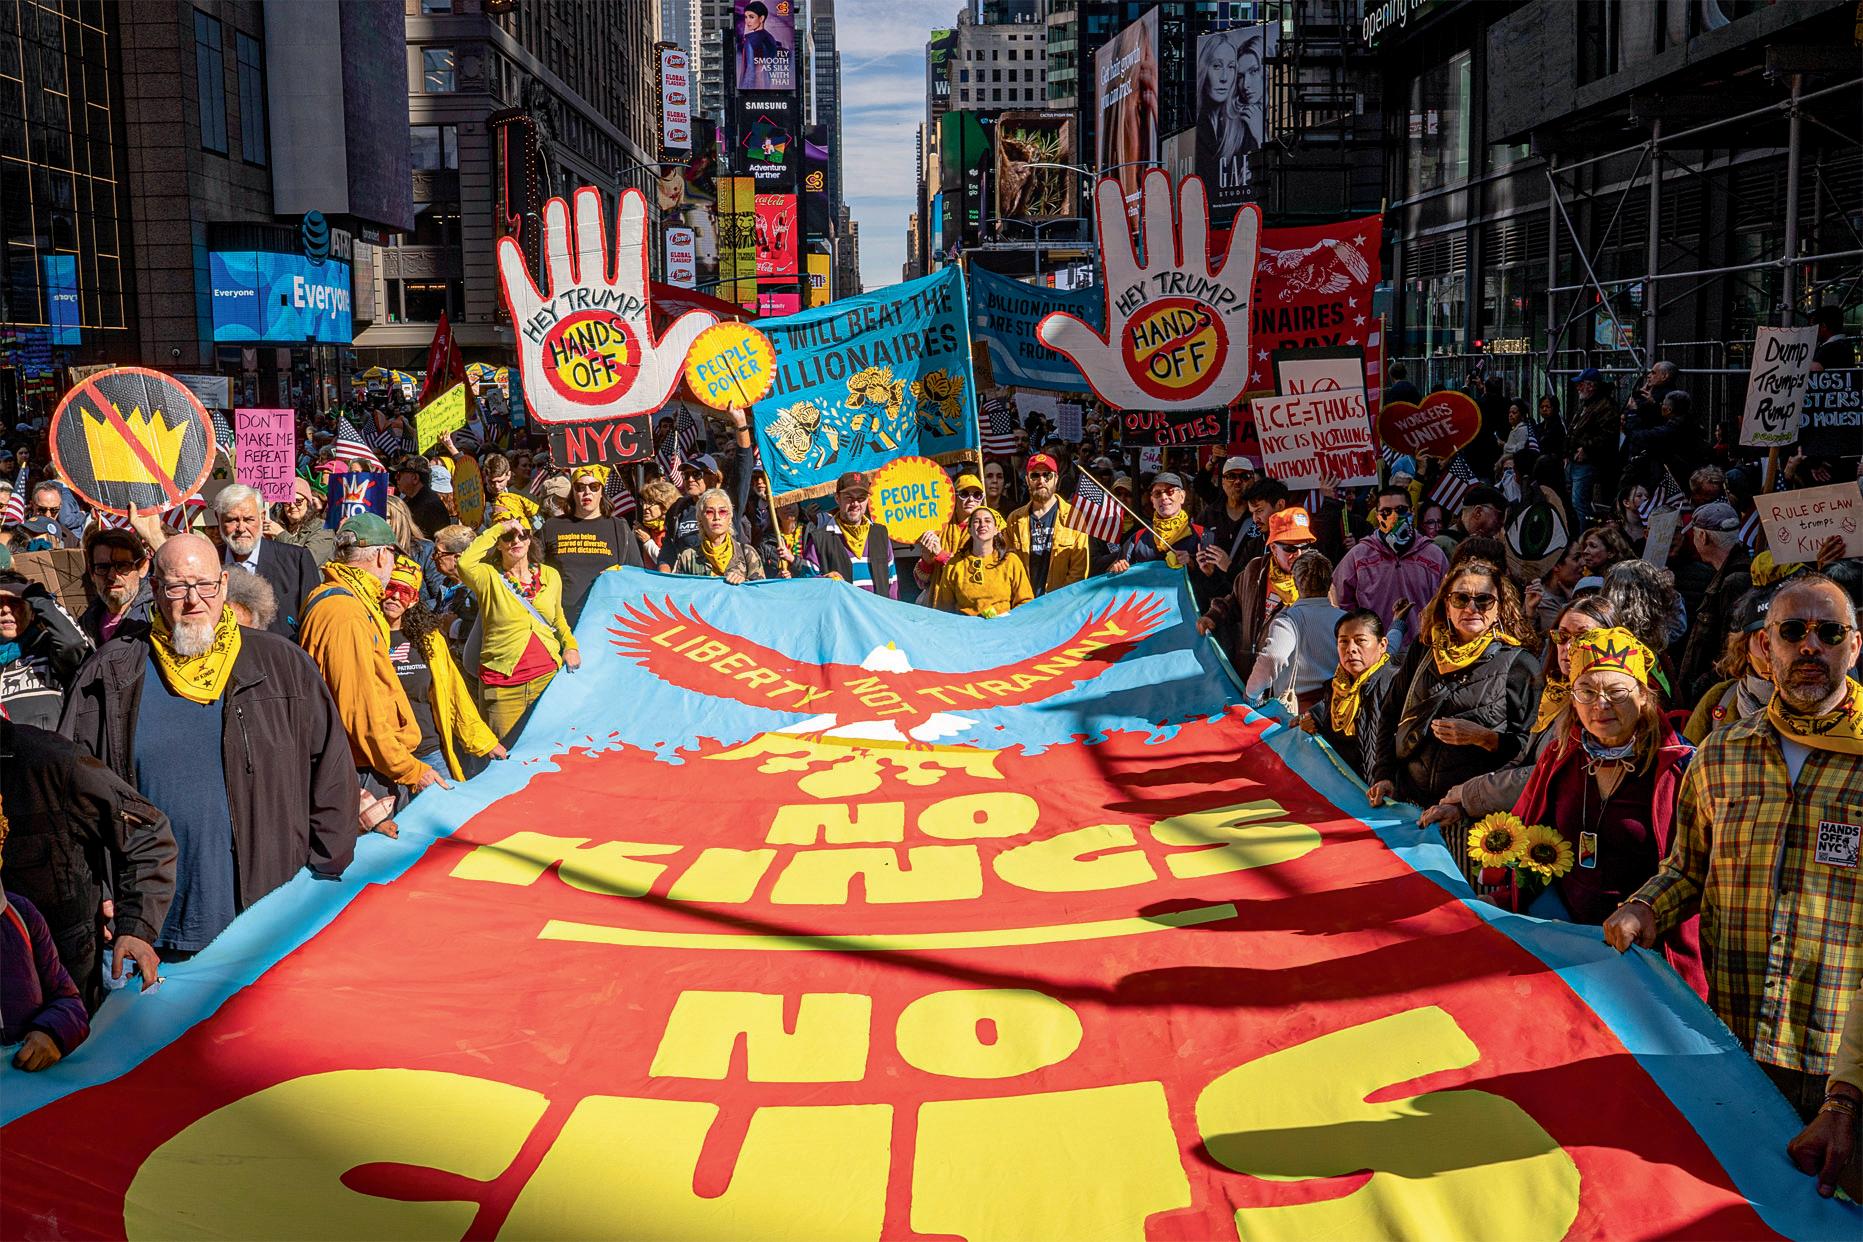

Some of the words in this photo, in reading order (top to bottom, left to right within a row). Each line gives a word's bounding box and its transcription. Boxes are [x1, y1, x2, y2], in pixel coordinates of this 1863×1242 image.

[745, 102, 787, 110] SAMSUNG
[754, 171, 780, 179] further
[1219, 189, 1251, 198] STUDIO
[214, 289, 254, 298] Everyone
[293, 275, 349, 319] Everyone
[1115, 281, 1148, 317] HEY
[1152, 271, 1247, 315] TRUMP!
[523, 300, 560, 345] HEY
[560, 287, 648, 322] TRUMP!
[786, 317, 842, 351] WILL
[847, 298, 904, 338] BEAT
[908, 283, 953, 321] THE
[990, 316, 1012, 333] ARE
[1016, 322, 1037, 338] ST
[1131, 302, 1213, 350] HANDS
[549, 318, 628, 368] HANDS
[1020, 342, 1057, 360] FROM
[1765, 336, 1809, 368] Dump
[572, 353, 617, 388] OFF
[696, 338, 759, 382] PEOPLE
[761, 323, 958, 399] ILLIONAIRES
[1149, 341, 1206, 379] OFF
[707, 359, 762, 398] POWER
[1808, 372, 1852, 391] NGS!
[238, 413, 288, 429] DON'T
[1125, 410, 1169, 430] OUR
[1394, 402, 1453, 431] WORKERS
[1754, 397, 1796, 432] Rump
[237, 432, 273, 447] MAKE
[276, 432, 293, 446] ME
[1154, 415, 1221, 446] CITIES
[1262, 435, 1294, 455] NYC
[1294, 433, 1310, 449] IS
[1311, 427, 1373, 450] NOTHING
[1403, 417, 1459, 447] UNITE
[565, 423, 638, 465] NYC
[244, 449, 289, 463] REPEAT
[237, 465, 290, 479] MYSELF
[1266, 457, 1318, 481] WITHOUT
[458, 474, 479, 494] PEOPLE
[880, 481, 941, 506] PEOPLE
[342, 504, 366, 518] NO
[460, 492, 480, 513] POWER
[884, 501, 938, 524] POWER
[1772, 505, 1809, 521] RULE
[1813, 502, 1826, 513] OF
[1829, 499, 1853, 511] LAW
[1799, 518, 1834, 529] trumps
[558, 533, 580, 541] imagine
[581, 533, 596, 541] being
[584, 541, 607, 549] diversity
[1797, 535, 1836, 553] KIN
[200, 668, 215, 679] KINGS
[651, 625, 833, 708] LIBERTY
[843, 676, 917, 717] NOT
[917, 620, 1128, 706] TYRANNY
[766, 792, 1038, 845] NO
[1821, 823, 1859, 836] HANDS
[1818, 841, 1842, 853] NYC
[1820, 833, 1842, 843] OFF
[449, 799, 1322, 904] KINGS
[648, 989, 1084, 1083] NO
